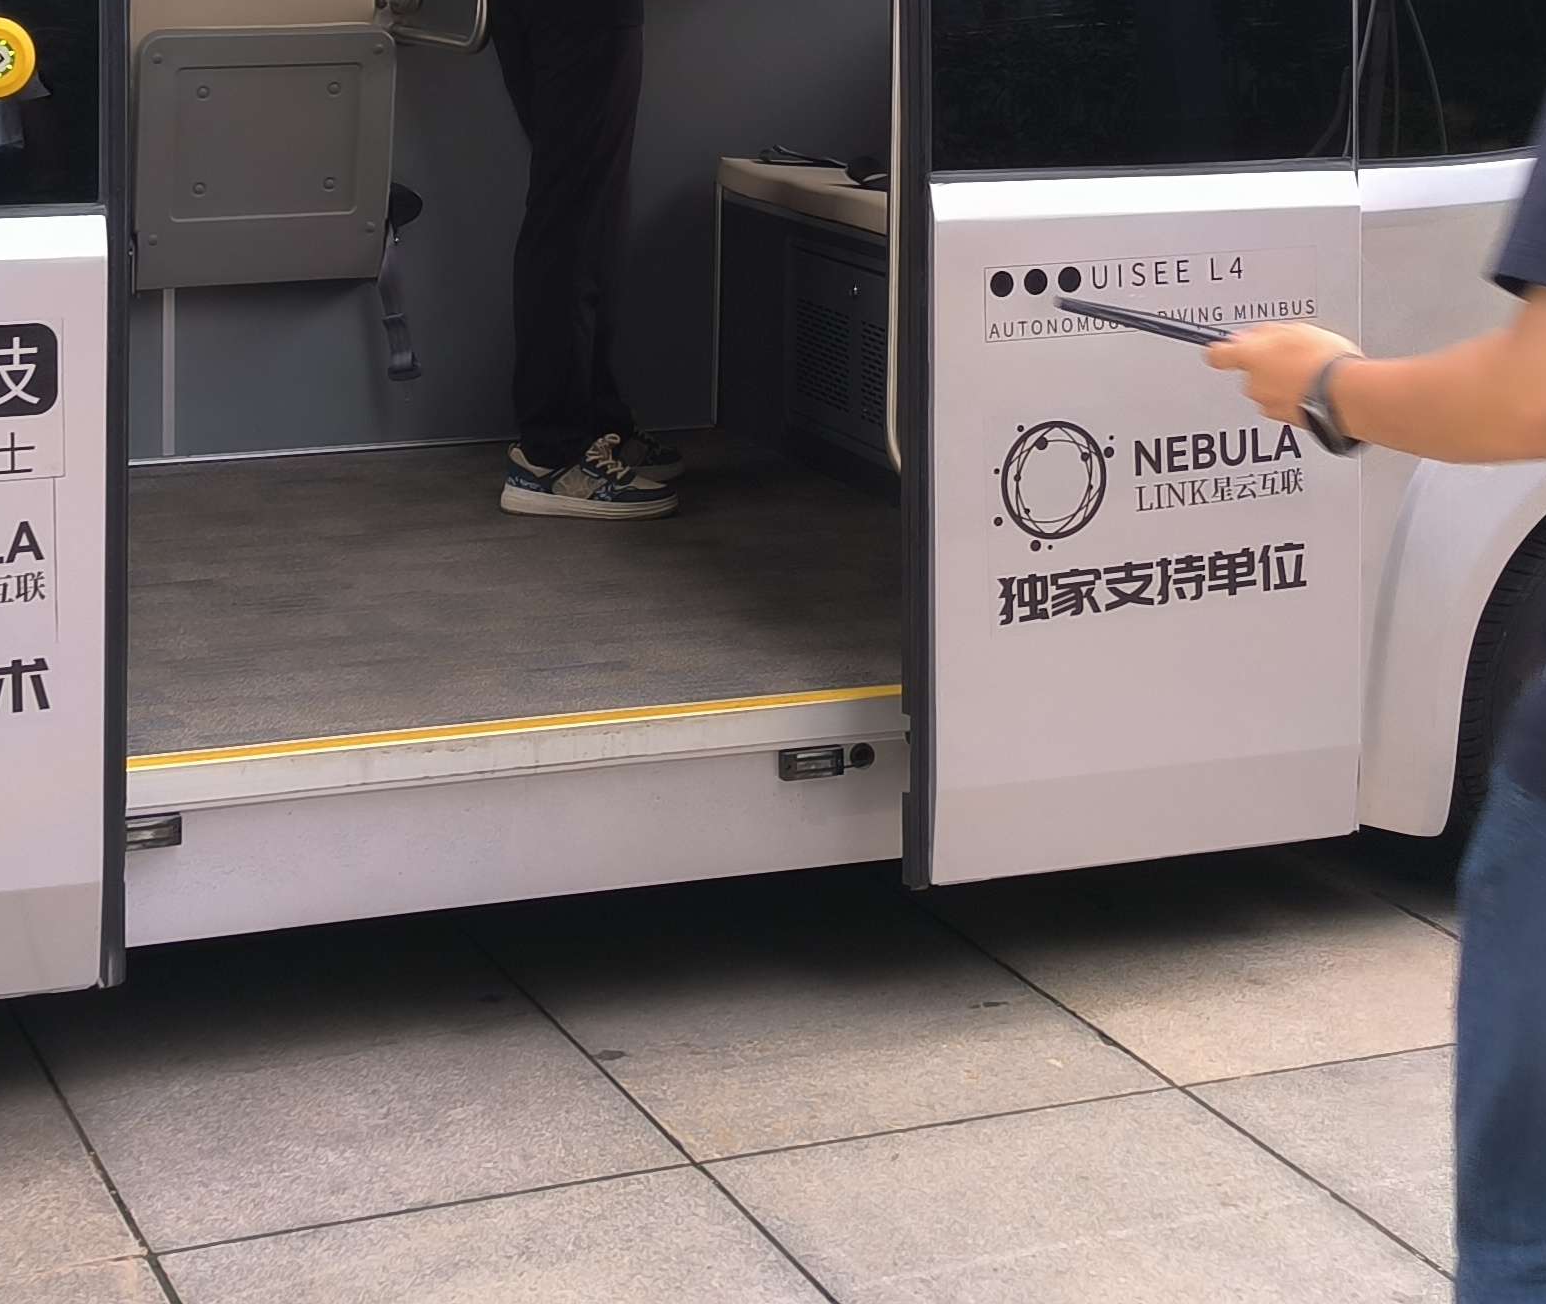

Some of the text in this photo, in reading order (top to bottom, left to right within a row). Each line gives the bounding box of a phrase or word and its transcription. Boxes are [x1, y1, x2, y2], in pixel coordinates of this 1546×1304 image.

[1091, 255, 1243, 290] UISEE L4
[1233, 299, 1315, 320] MINIBUS
[1134, 425, 1302, 476] NEBULA
[997, 541, 1308, 626] 独家支持单位
